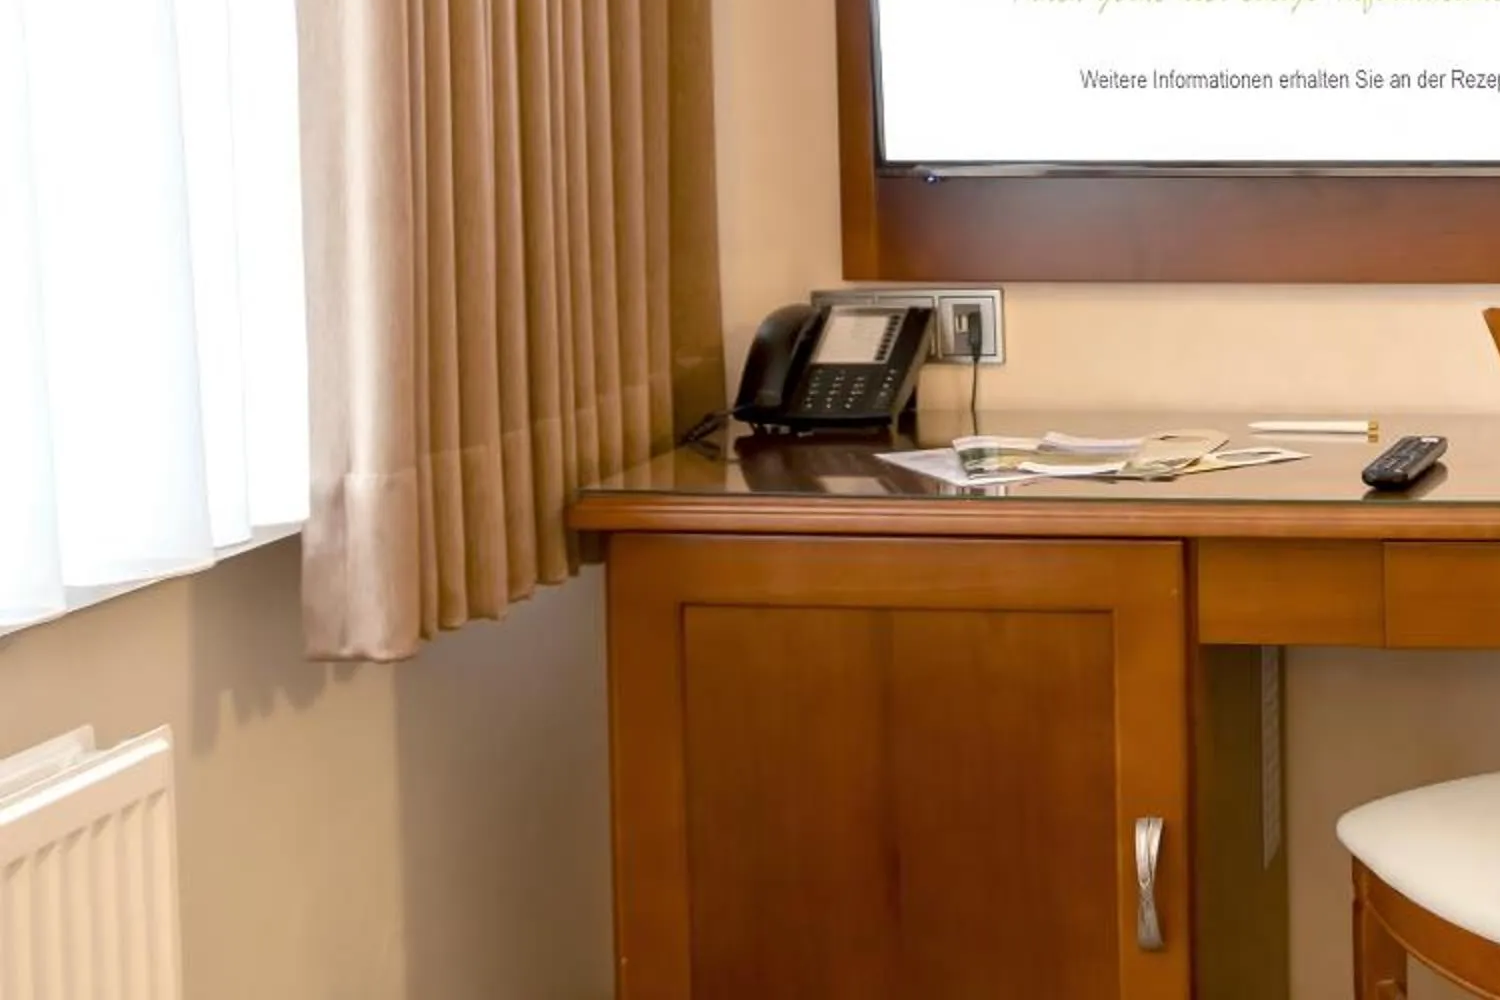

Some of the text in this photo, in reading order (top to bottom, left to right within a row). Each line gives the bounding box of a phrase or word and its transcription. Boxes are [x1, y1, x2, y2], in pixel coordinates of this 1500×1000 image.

[1079, 69, 1148, 90] Weitere
[1153, 69, 1273, 90] Informationen
[1278, 69, 1350, 90] erhalten
[1355, 69, 1385, 90] Sie
[1389, 73, 1412, 89] an
[1417, 69, 1447, 89] der
